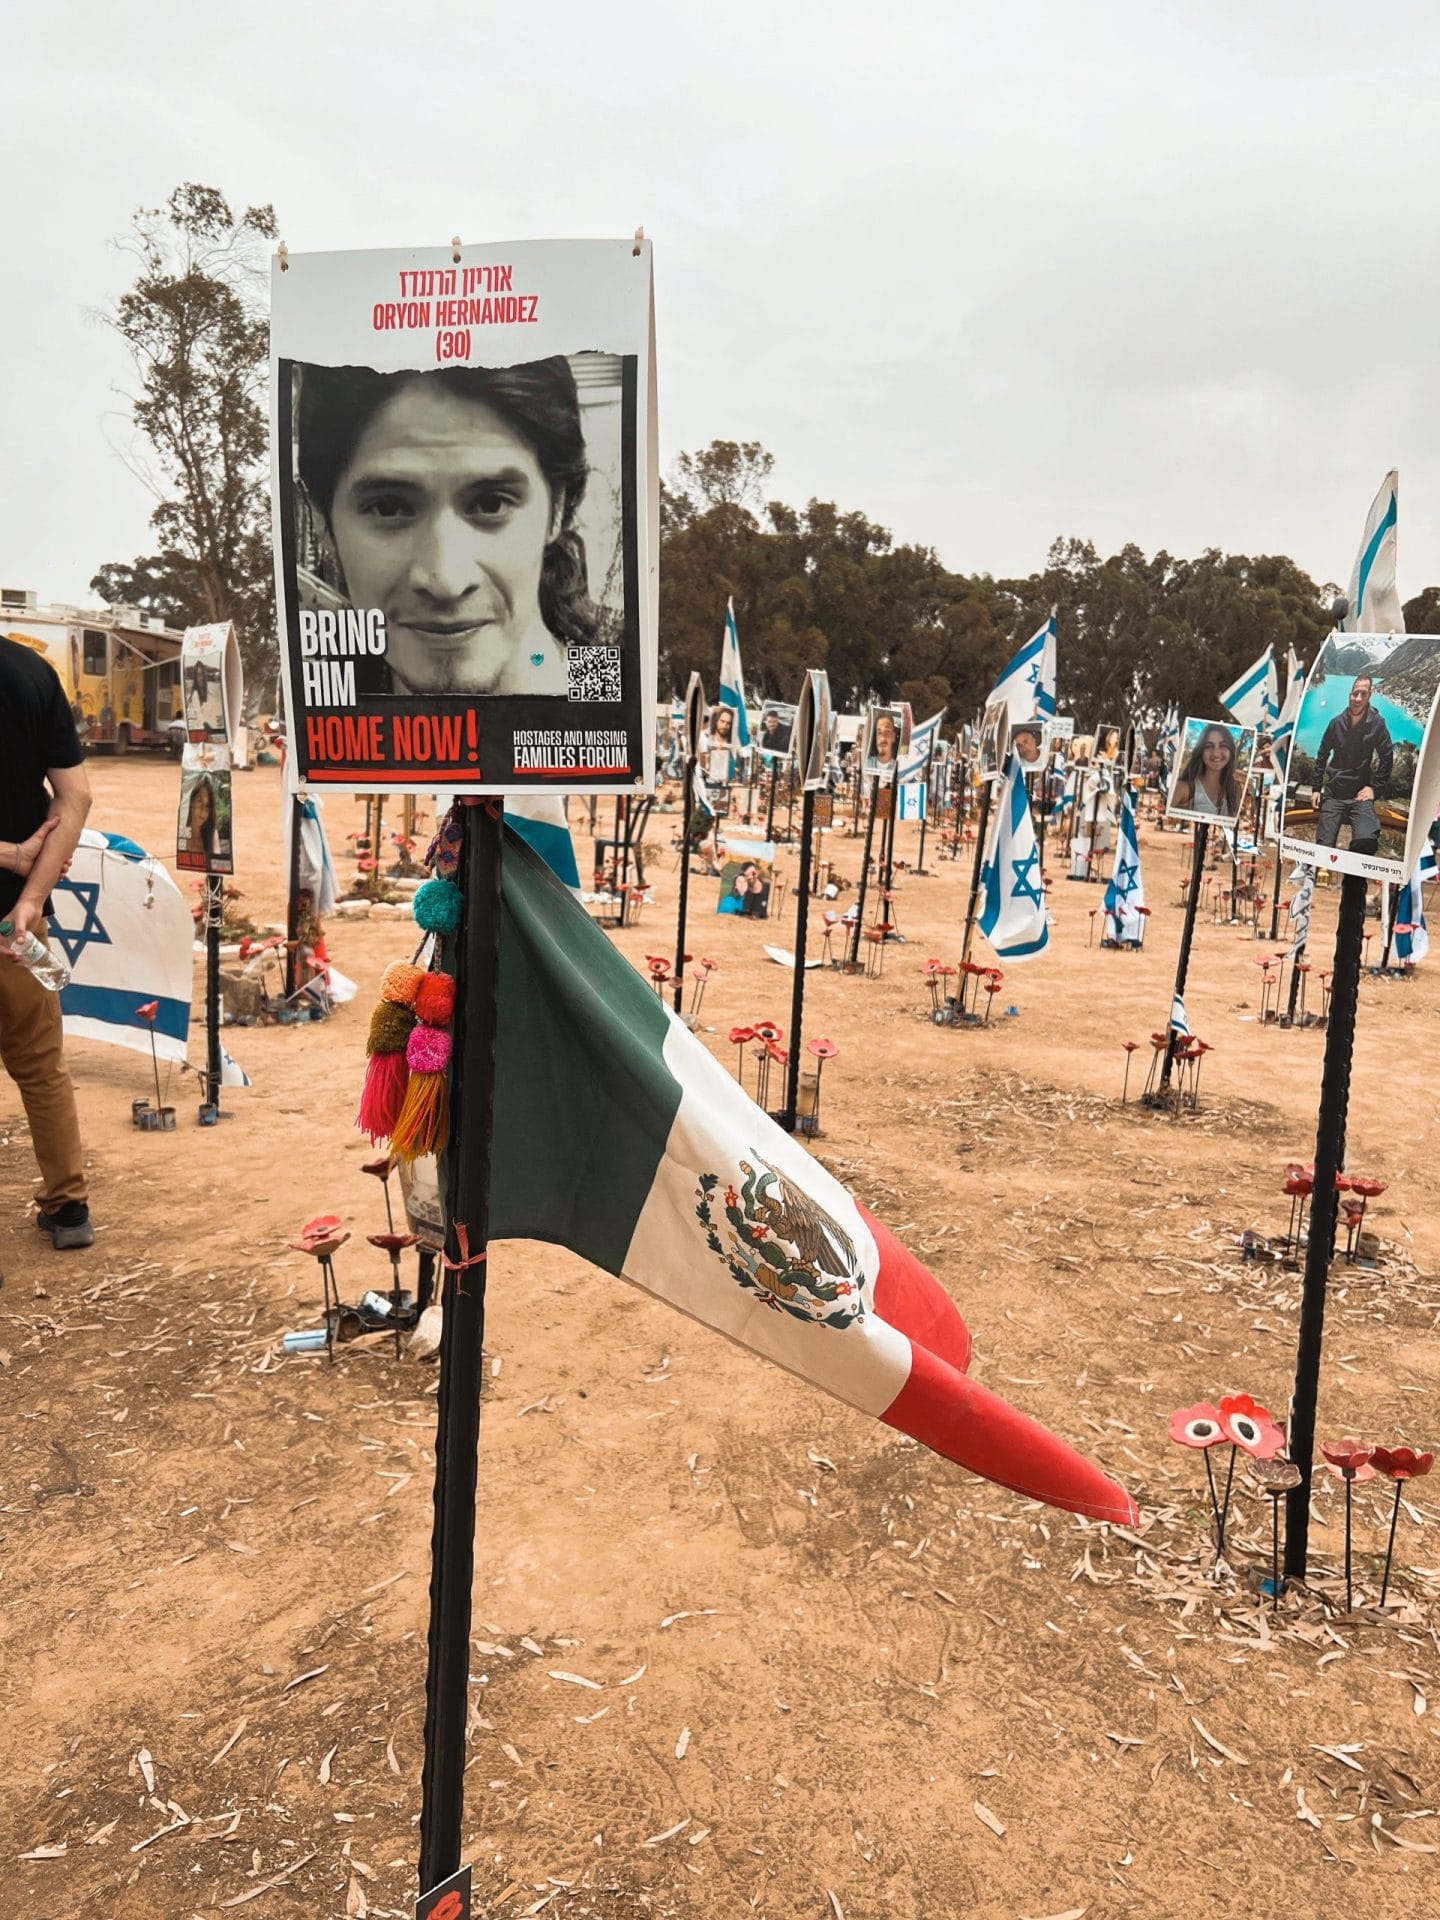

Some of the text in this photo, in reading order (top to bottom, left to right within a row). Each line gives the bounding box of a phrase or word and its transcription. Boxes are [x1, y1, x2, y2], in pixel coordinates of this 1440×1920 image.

[399, 265, 513, 298] אוריון הרננדז
[372, 295, 539, 331] ORYON HERNANDEZ
[435, 329, 472, 362] (30)
[298, 608, 386, 658] BRING
[302, 659, 357, 707] HIM
[305, 708, 480, 763] HOME NOW!
[513, 730, 627, 746] HOSTAGES AND MISSING
[514, 746, 629, 769] FAMILIES FORUM
